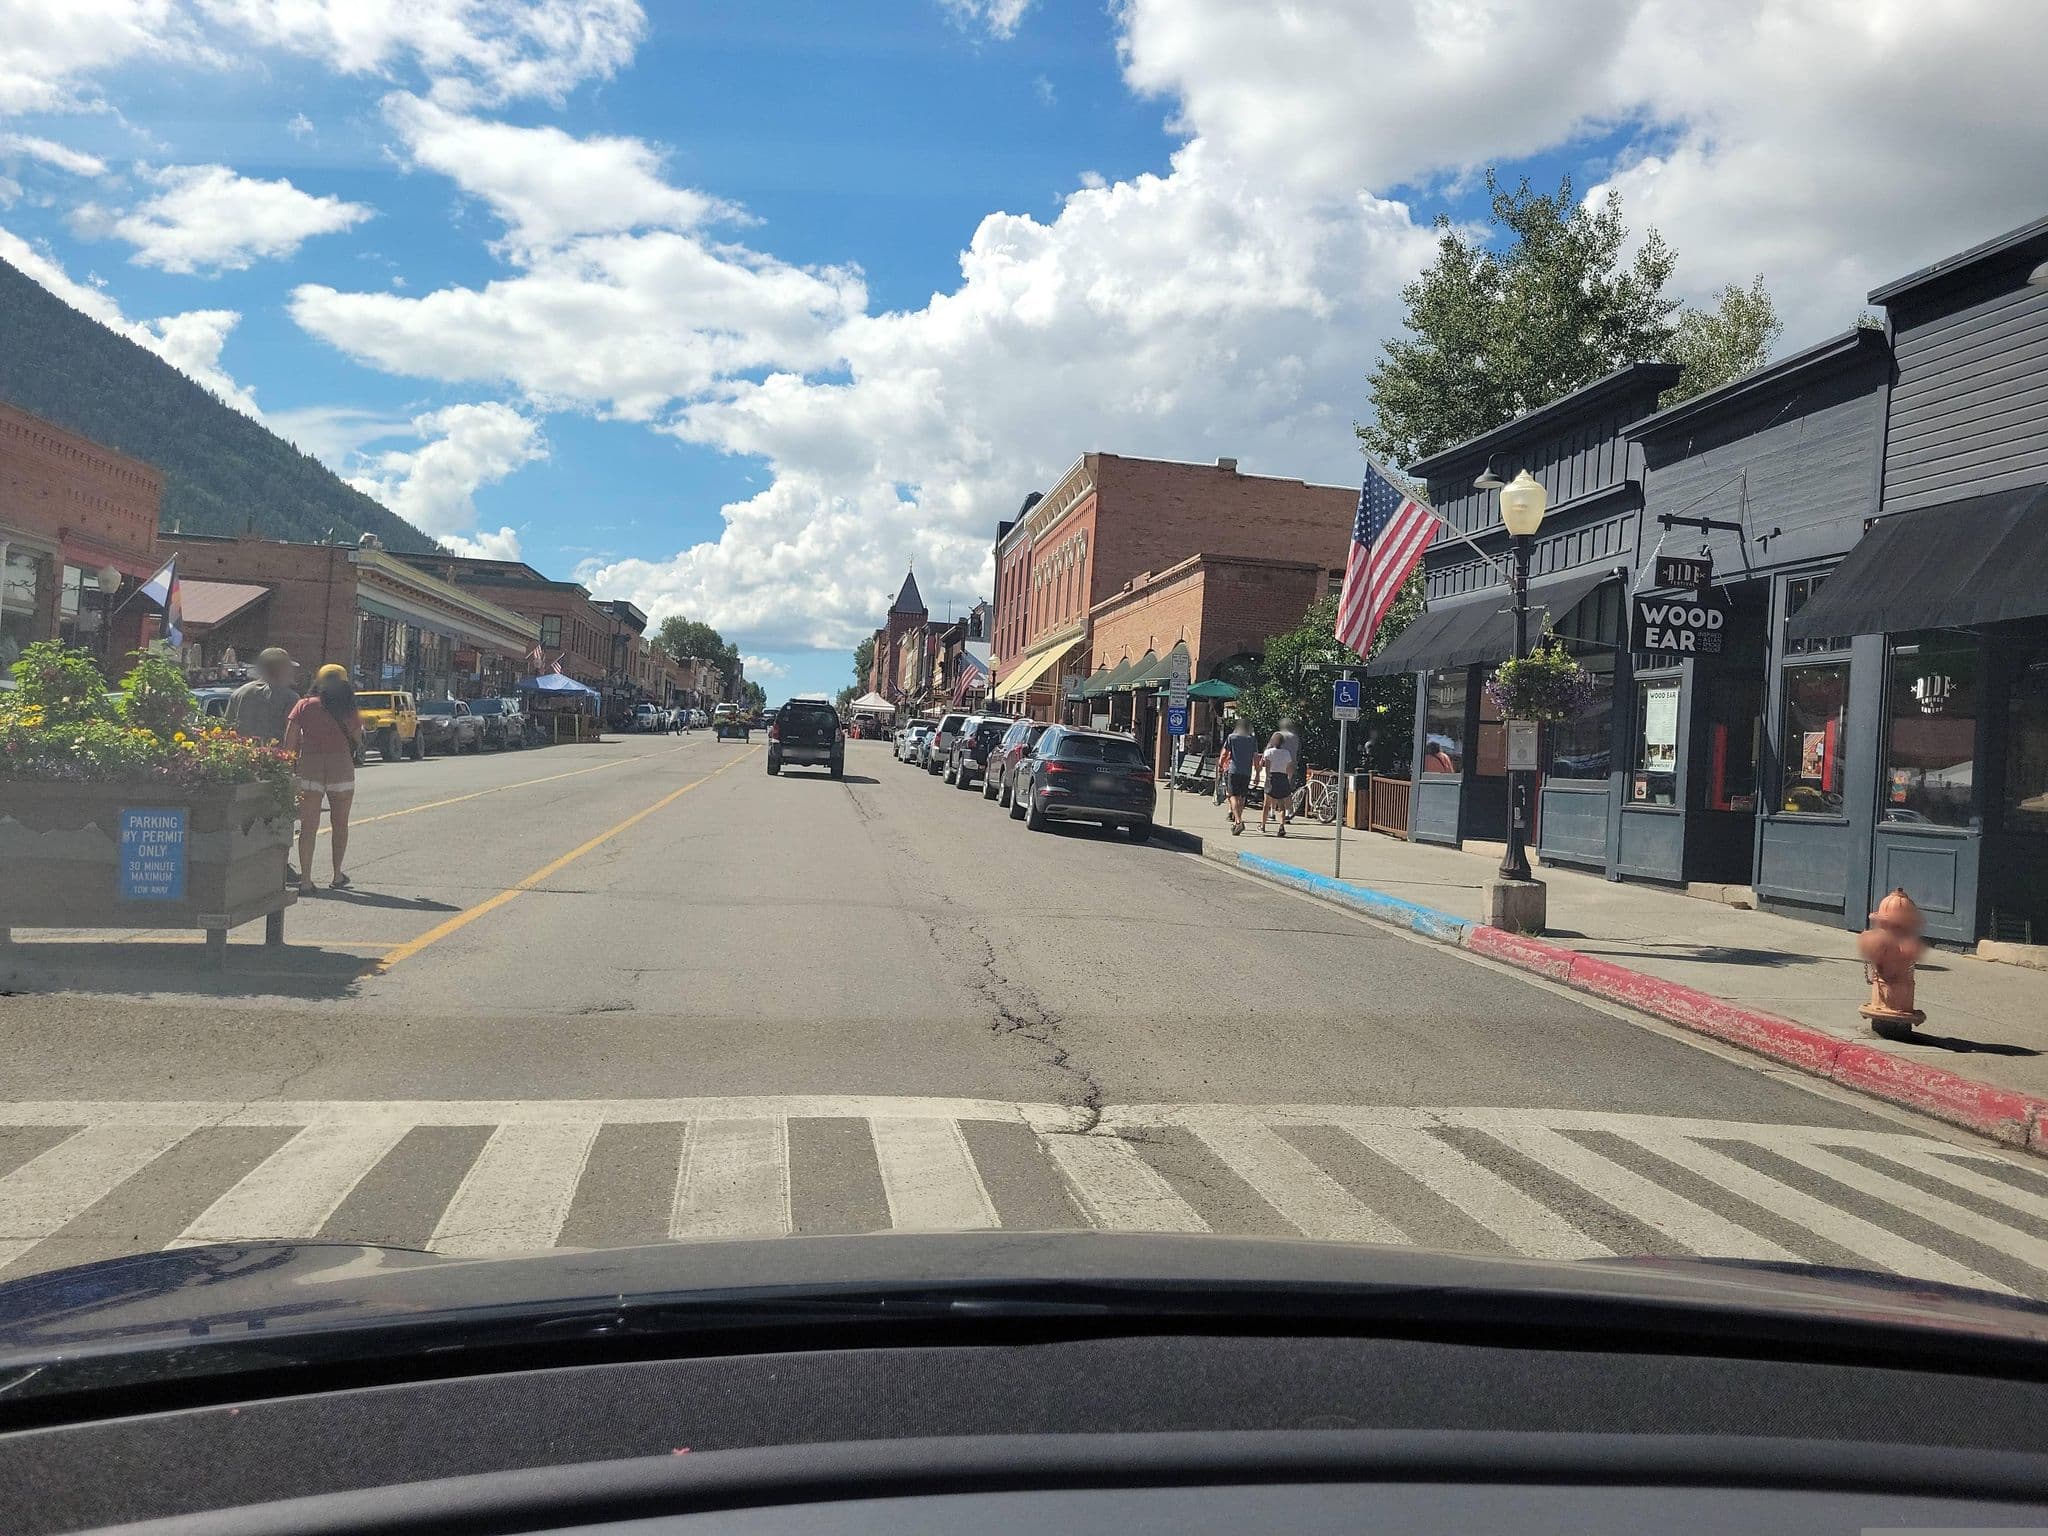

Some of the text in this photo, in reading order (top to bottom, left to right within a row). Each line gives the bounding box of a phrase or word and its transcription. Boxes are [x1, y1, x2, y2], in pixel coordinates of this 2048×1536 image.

[1668, 564, 1700, 583] RIDE
[1640, 603, 1723, 630] WOOD
[1645, 627, 1696, 652] EAR
[1915, 675, 1950, 699] RIDE
[130, 816, 178, 829] PARKING
[123, 830, 184, 843] BY PERMIT
[139, 845, 167, 857] ONLY
[128, 861, 176, 872] 30 MINUTE
[131, 871, 173, 882] MAXIMUM
